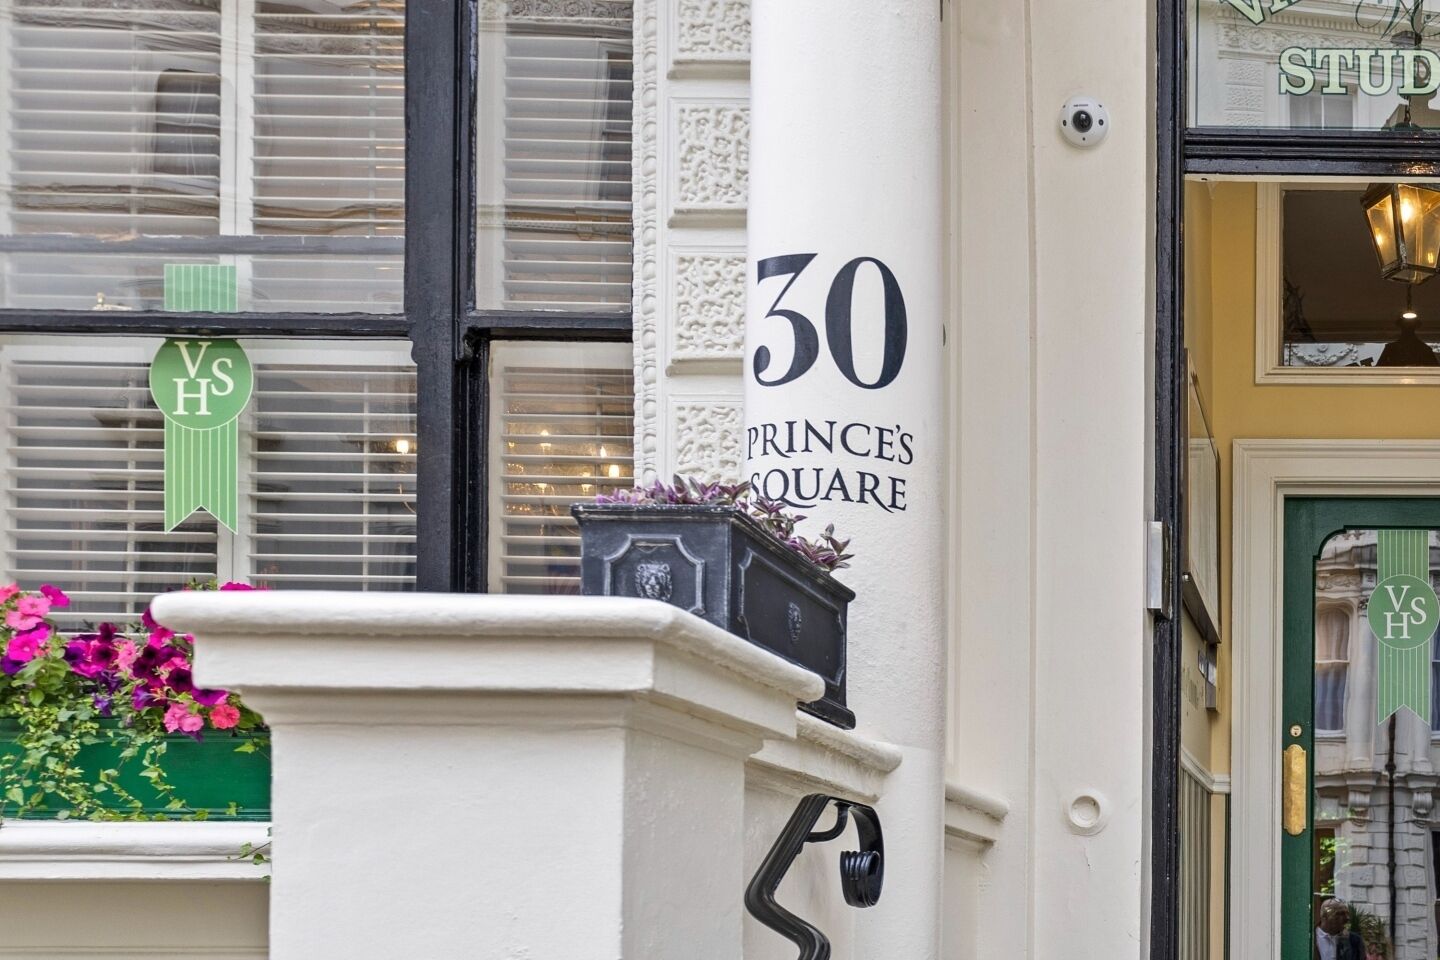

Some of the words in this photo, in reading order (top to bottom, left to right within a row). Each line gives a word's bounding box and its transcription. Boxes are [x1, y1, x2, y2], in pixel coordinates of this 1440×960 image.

[753, 253, 908, 390] 30
[747, 419, 914, 465] PRINCE'S
[750, 468, 907, 513] SQUARE
